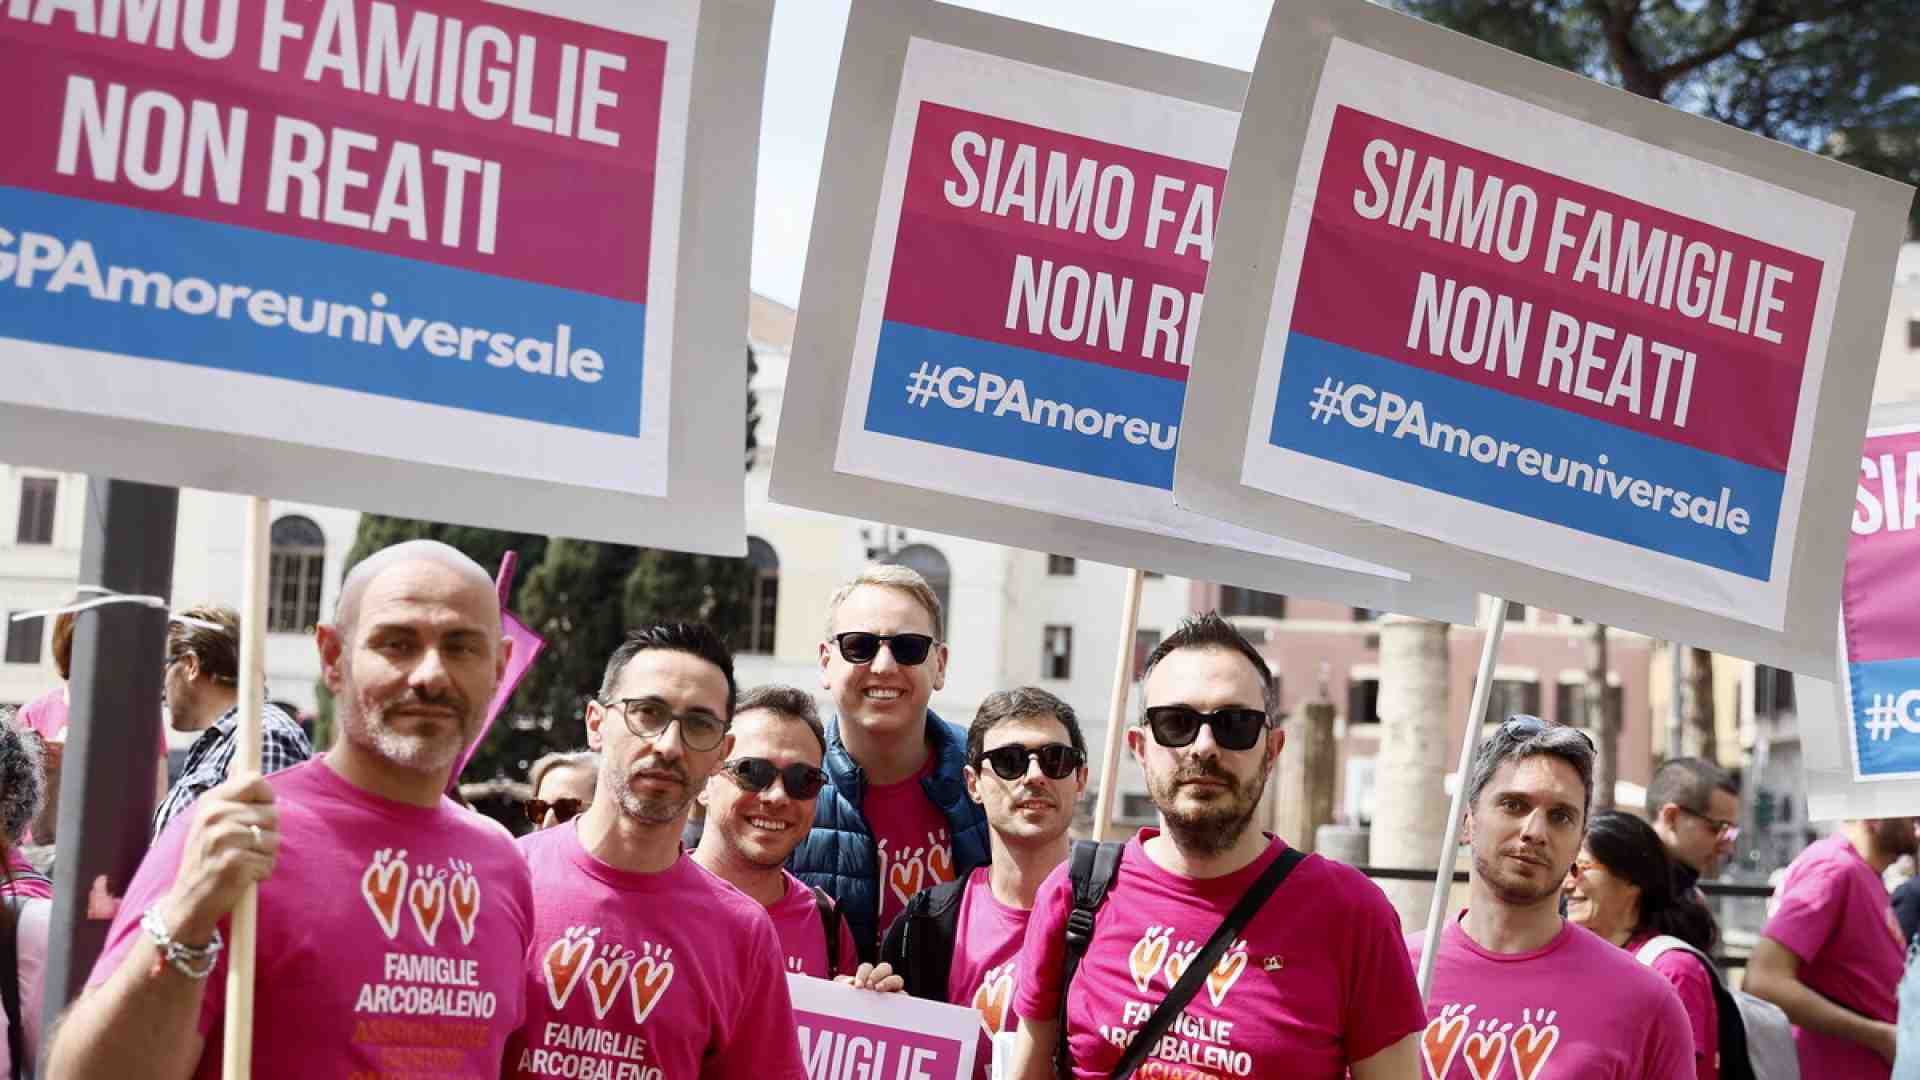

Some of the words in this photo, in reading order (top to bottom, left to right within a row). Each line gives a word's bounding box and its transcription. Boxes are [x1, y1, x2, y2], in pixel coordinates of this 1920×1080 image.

[259, 0, 627, 147] FAMIGLIE
[57, 75, 249, 205] NON
[266, 115, 501, 254] REATI
[943, 130, 1135, 241] SIAMO
[1353, 139, 1538, 263] SIAMO
[1543, 197, 1794, 345] FAMIGLIE
[1004, 254, 1134, 353] NON
[1406, 271, 1533, 379] NON
[1537, 310, 1697, 427] REATI
[905, 361, 1177, 451] #GPAmoreu
[1309, 377, 1751, 536] #GPAmoreuniversale
[354, 983, 497, 1019] ARCOBALENO
[384, 952, 479, 987] FAMIGLIE
[543, 1021, 648, 1060] FAMIGLIE
[1122, 1001, 1233, 1046] FAIGLIE
